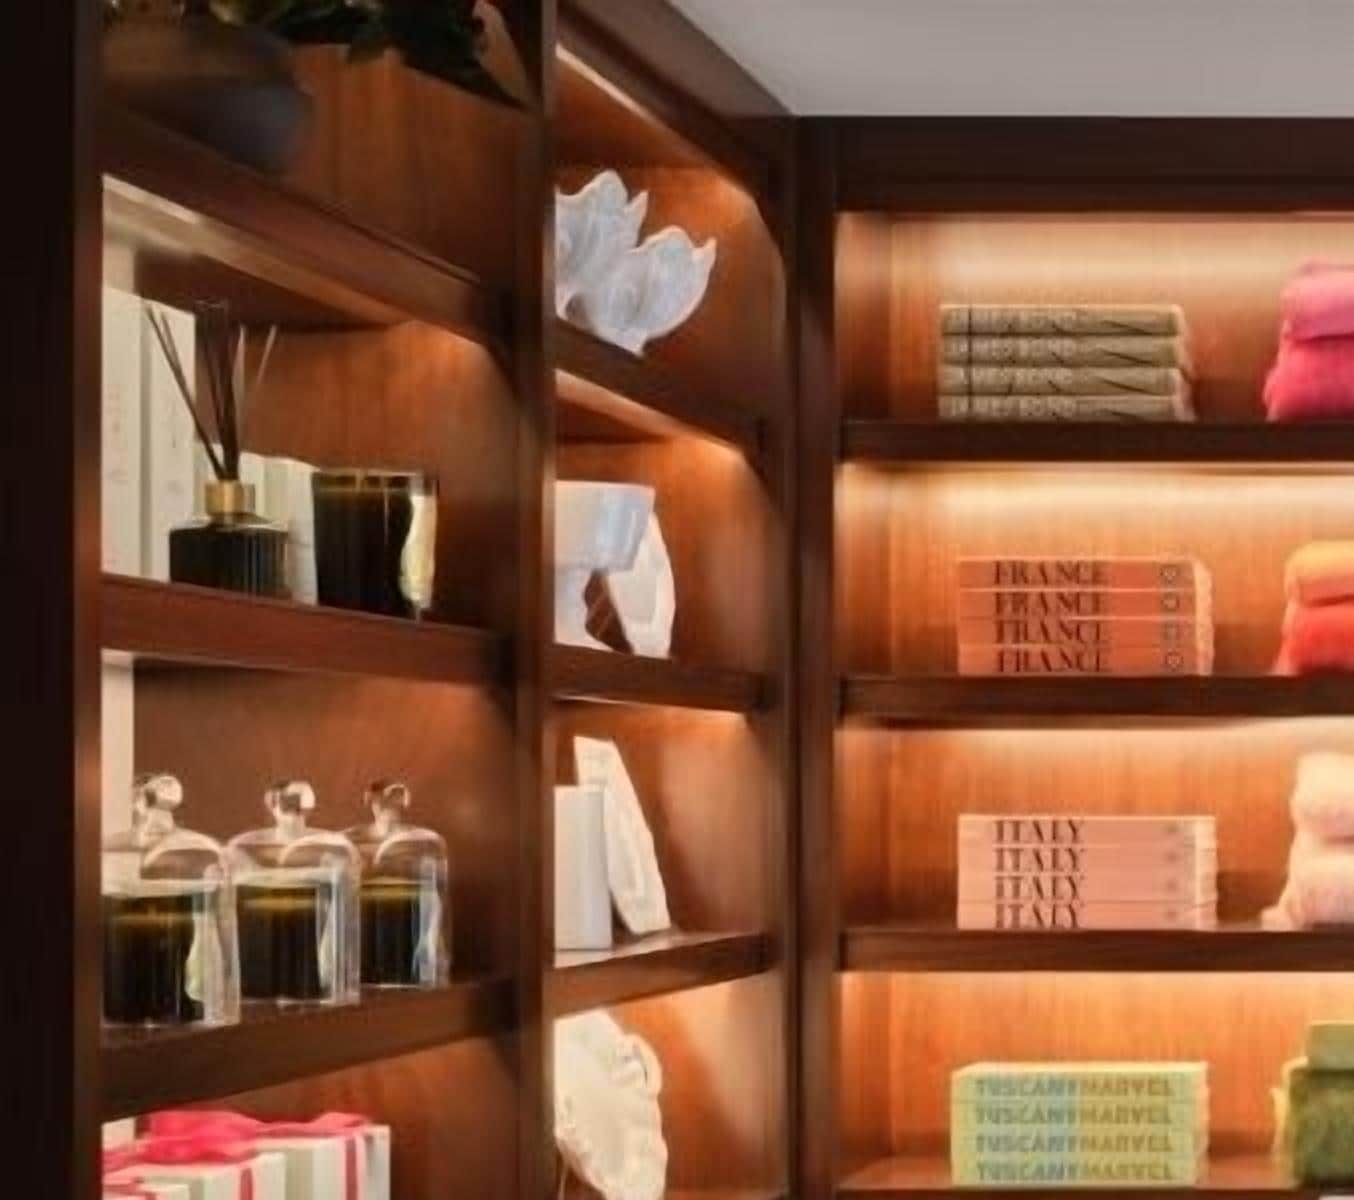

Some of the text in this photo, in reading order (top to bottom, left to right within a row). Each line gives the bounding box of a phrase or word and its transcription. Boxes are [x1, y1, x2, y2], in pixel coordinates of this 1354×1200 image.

[994, 560, 1108, 585] FRANCE
[994, 590, 1108, 615] FRANCE
[995, 619, 1109, 644] FRANCE
[996, 650, 1111, 672] FRANCE
[994, 820, 1085, 843] ITALY
[994, 848, 1085, 872] ITALY
[994, 875, 1085, 899] ITALY
[994, 903, 1085, 929] ITALY
